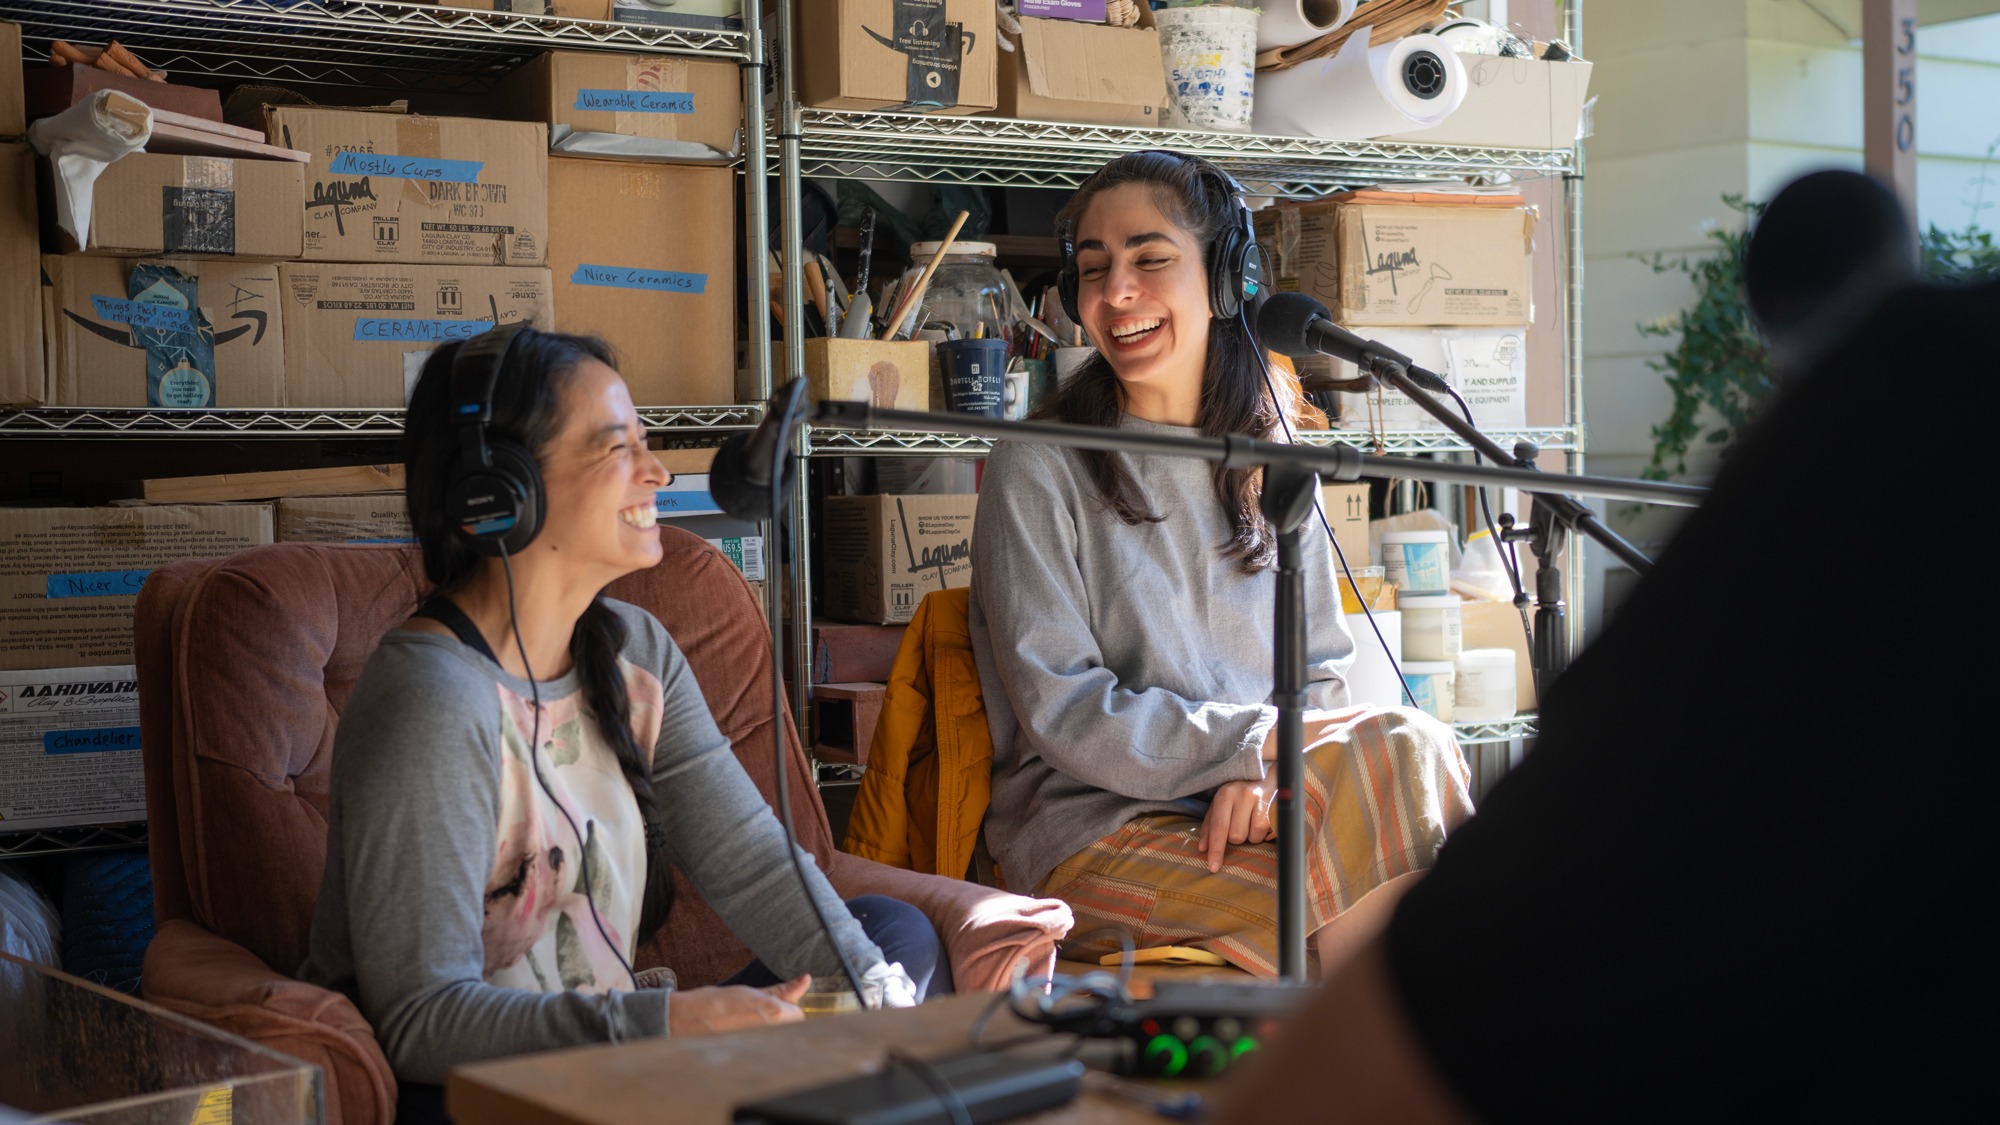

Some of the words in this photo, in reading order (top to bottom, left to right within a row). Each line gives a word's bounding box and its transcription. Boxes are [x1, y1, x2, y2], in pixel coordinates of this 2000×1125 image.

[1061, 0, 1082, 8] Gloves
[899, 37, 911, 45] free
[912, 38, 941, 48] listening
[912, 58, 941, 68] streaming
[940, 63, 958, 71] video
[583, 94, 637, 110] Wearable
[640, 96, 693, 110] Ceramics
[343, 154, 396, 175] Mostly
[401, 162, 442, 178] Cups
[429, 182, 461, 200] DARK
[465, 182, 507, 204] BROWN
[305, 176, 377, 236] aguna
[314, 210, 334, 220] CLAY
[340, 203, 378, 216] COMPANY
[453, 204, 467, 217] WC
[1361, 207, 1420, 296] Laguna
[584, 269, 618, 282] Nicer
[627, 271, 692, 288] Ceramics
[137, 305, 157, 316] that
[162, 310, 181, 318] can
[500, 310, 518, 320] CLAY
[362, 320, 473, 339] CERAMICS
[1472, 378, 1488, 386] AND
[1488, 376, 1518, 386] SUPPLIES
[1474, 396, 1510, 404] EQUIPMENT
[371, 511, 400, 519] Quality:
[722, 544, 732, 552] US
[732, 543, 742, 552] 9.5
[896, 497, 973, 591] Laguna
[921, 572, 939, 582] CLAY
[943, 564, 973, 576] COMPAN
[68, 578, 112, 594] Nicer
[13, 592, 48, 600] PRODUCT
[118, 640, 134, 648] Clay
[87, 648, 132, 657] guarantee
[27, 695, 60, 711] Clay
[74, 694, 136, 707] Supplies
[53, 730, 135, 749] Chandelier
